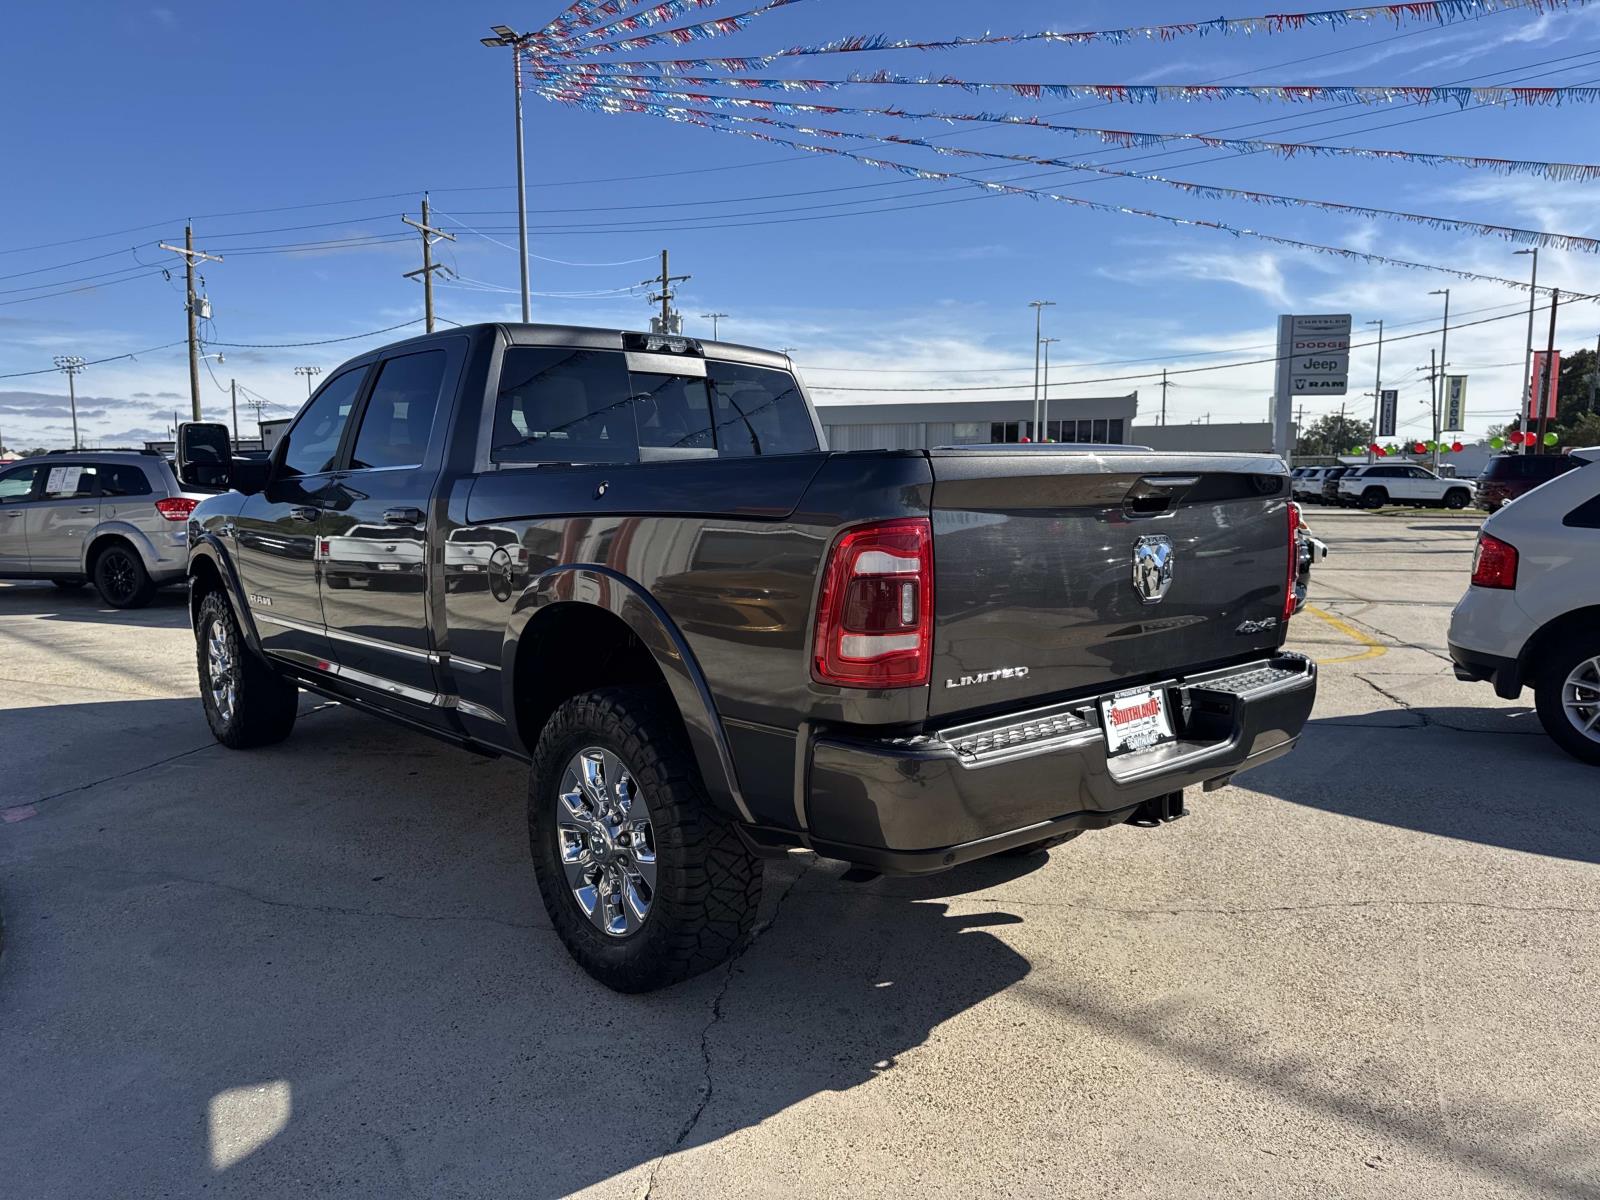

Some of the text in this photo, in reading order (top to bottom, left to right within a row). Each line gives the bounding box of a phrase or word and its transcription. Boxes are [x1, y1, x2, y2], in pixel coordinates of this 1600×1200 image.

[1295, 341, 1347, 349] DODGE
[1303, 358, 1338, 371] Jeep
[1449, 387, 1460, 429] Jeep
[250, 593, 272, 605] RAM
[945, 666, 1029, 689] LIMITED
[1111, 697, 1159, 727] SOUTHLAND
